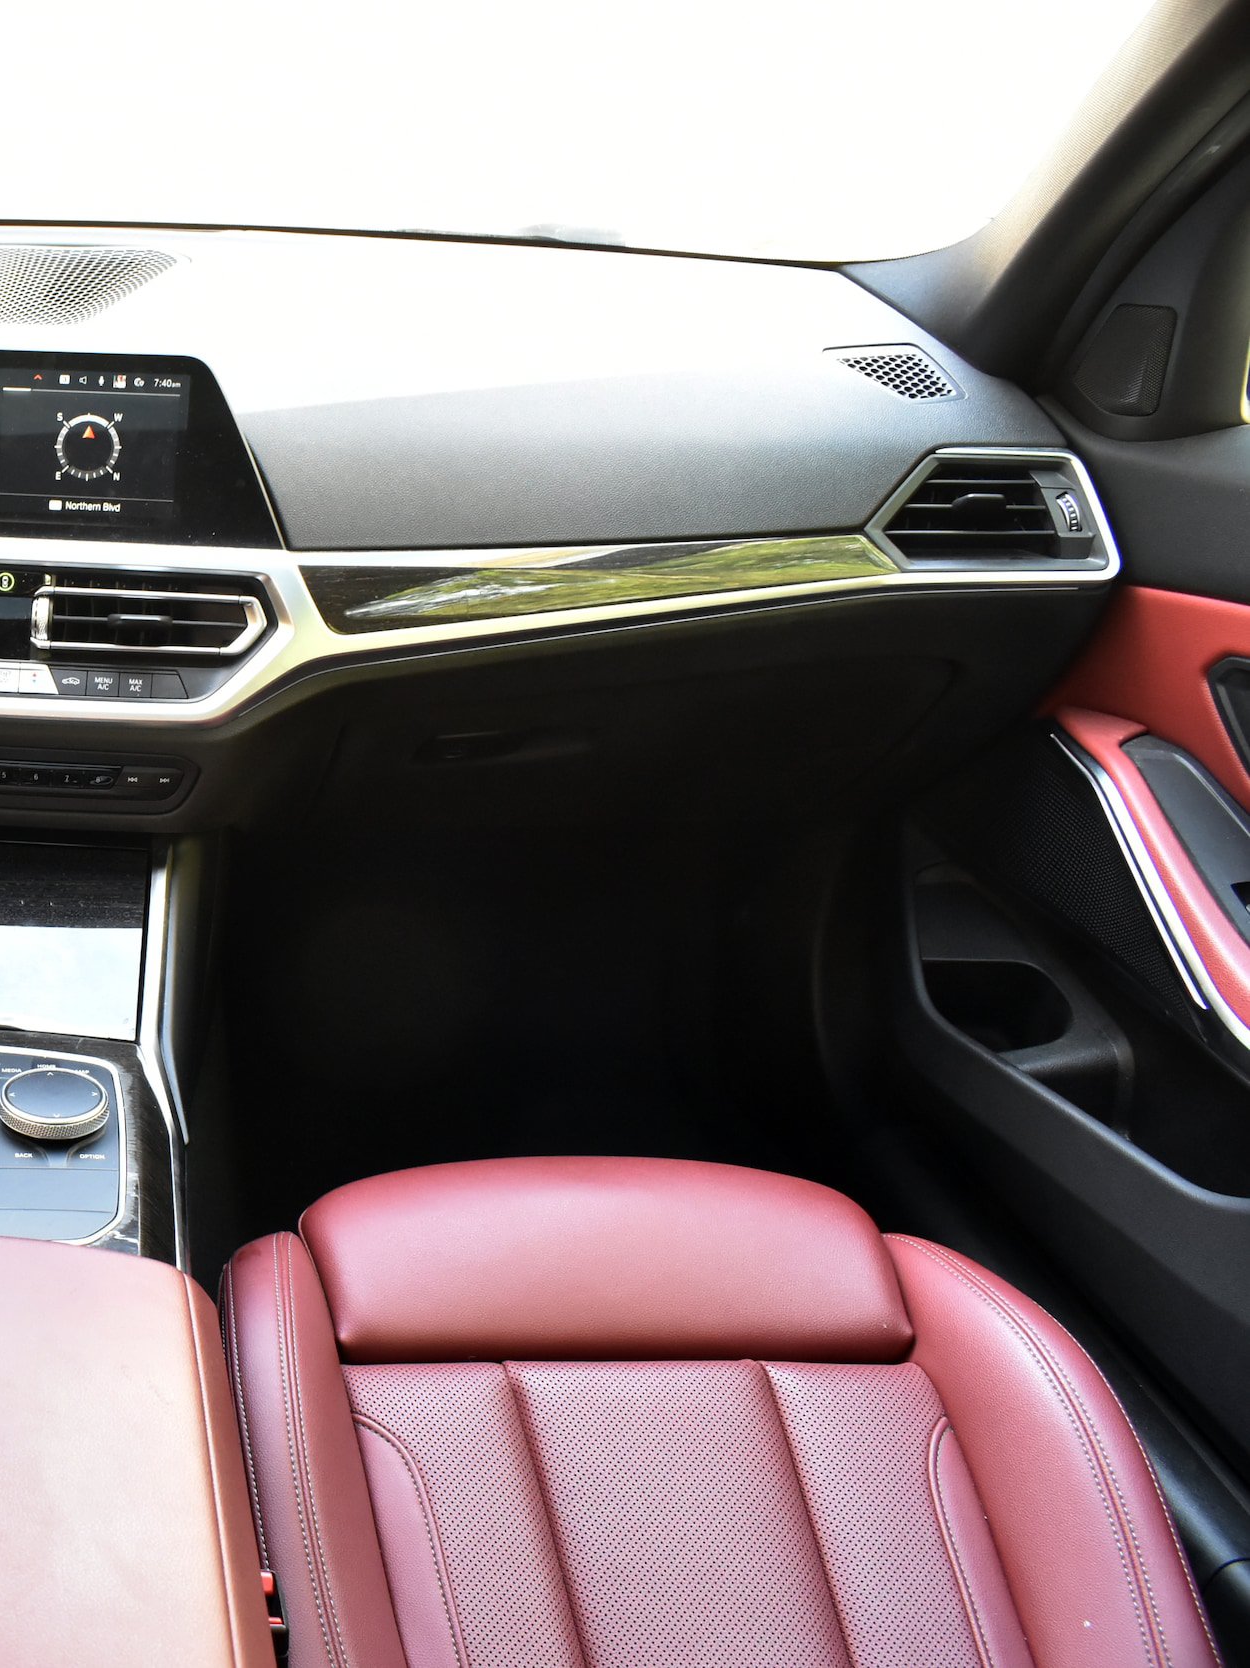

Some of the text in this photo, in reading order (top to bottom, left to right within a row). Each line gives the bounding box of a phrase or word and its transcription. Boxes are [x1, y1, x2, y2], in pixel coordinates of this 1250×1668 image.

[56, 412, 63, 422] S
[113, 413, 124, 422] W
[55, 472, 62, 481] E
[113, 472, 121, 482] N
[65, 501, 121, 513] Northern Blvd
[94, 676, 113, 685] MENU
[129, 678, 143, 686] MAX
[1, 771, 7, 779] 5
